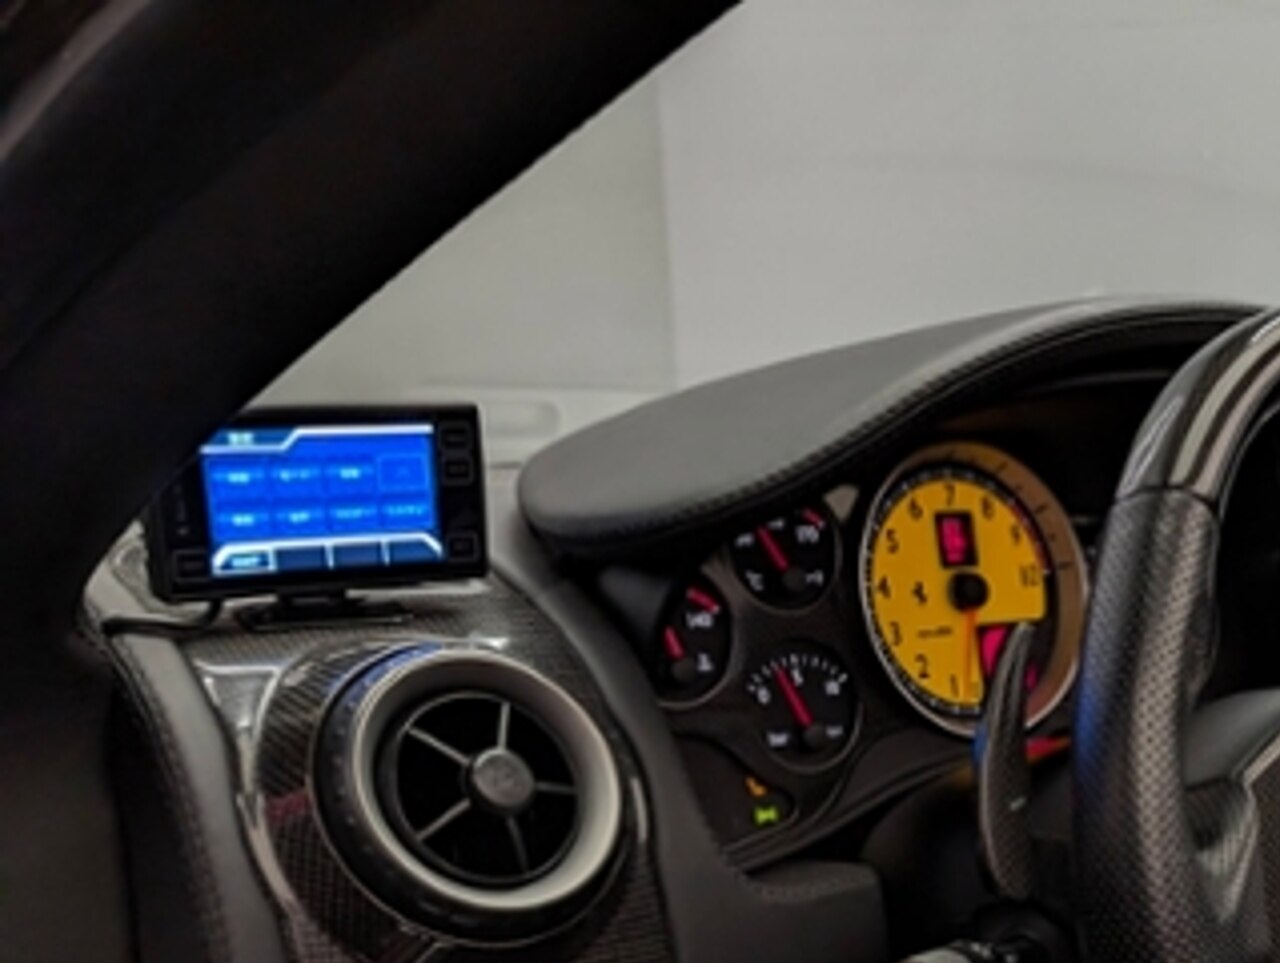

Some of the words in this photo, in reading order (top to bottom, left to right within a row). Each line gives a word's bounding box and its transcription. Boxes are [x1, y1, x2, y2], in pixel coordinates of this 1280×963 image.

[943, 484, 956, 506] 7
[907, 498, 923, 520] 6
[981, 498, 996, 520] 8
[885, 529, 900, 554] 5
[877, 576, 892, 599] 4
[889, 622, 903, 647] 3
[914, 654, 930, 680] 2
